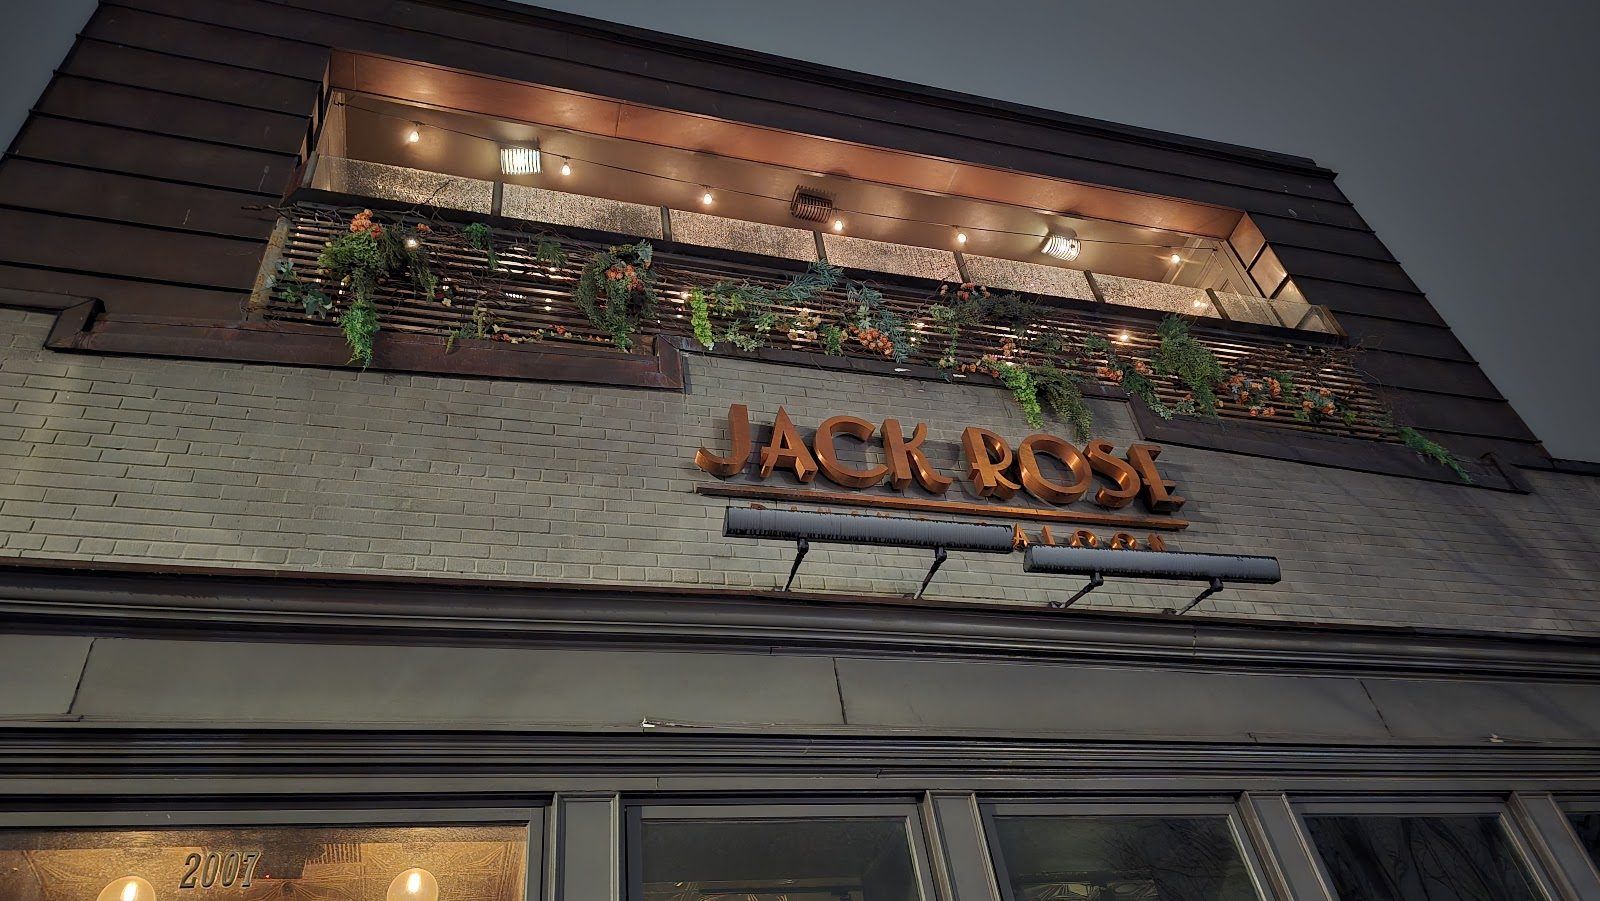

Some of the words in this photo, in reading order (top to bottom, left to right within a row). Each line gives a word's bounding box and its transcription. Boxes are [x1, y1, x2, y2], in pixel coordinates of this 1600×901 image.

[694, 404, 952, 494] JACK
[961, 426, 1186, 512] ROSE
[179, 851, 261, 889] 2007
